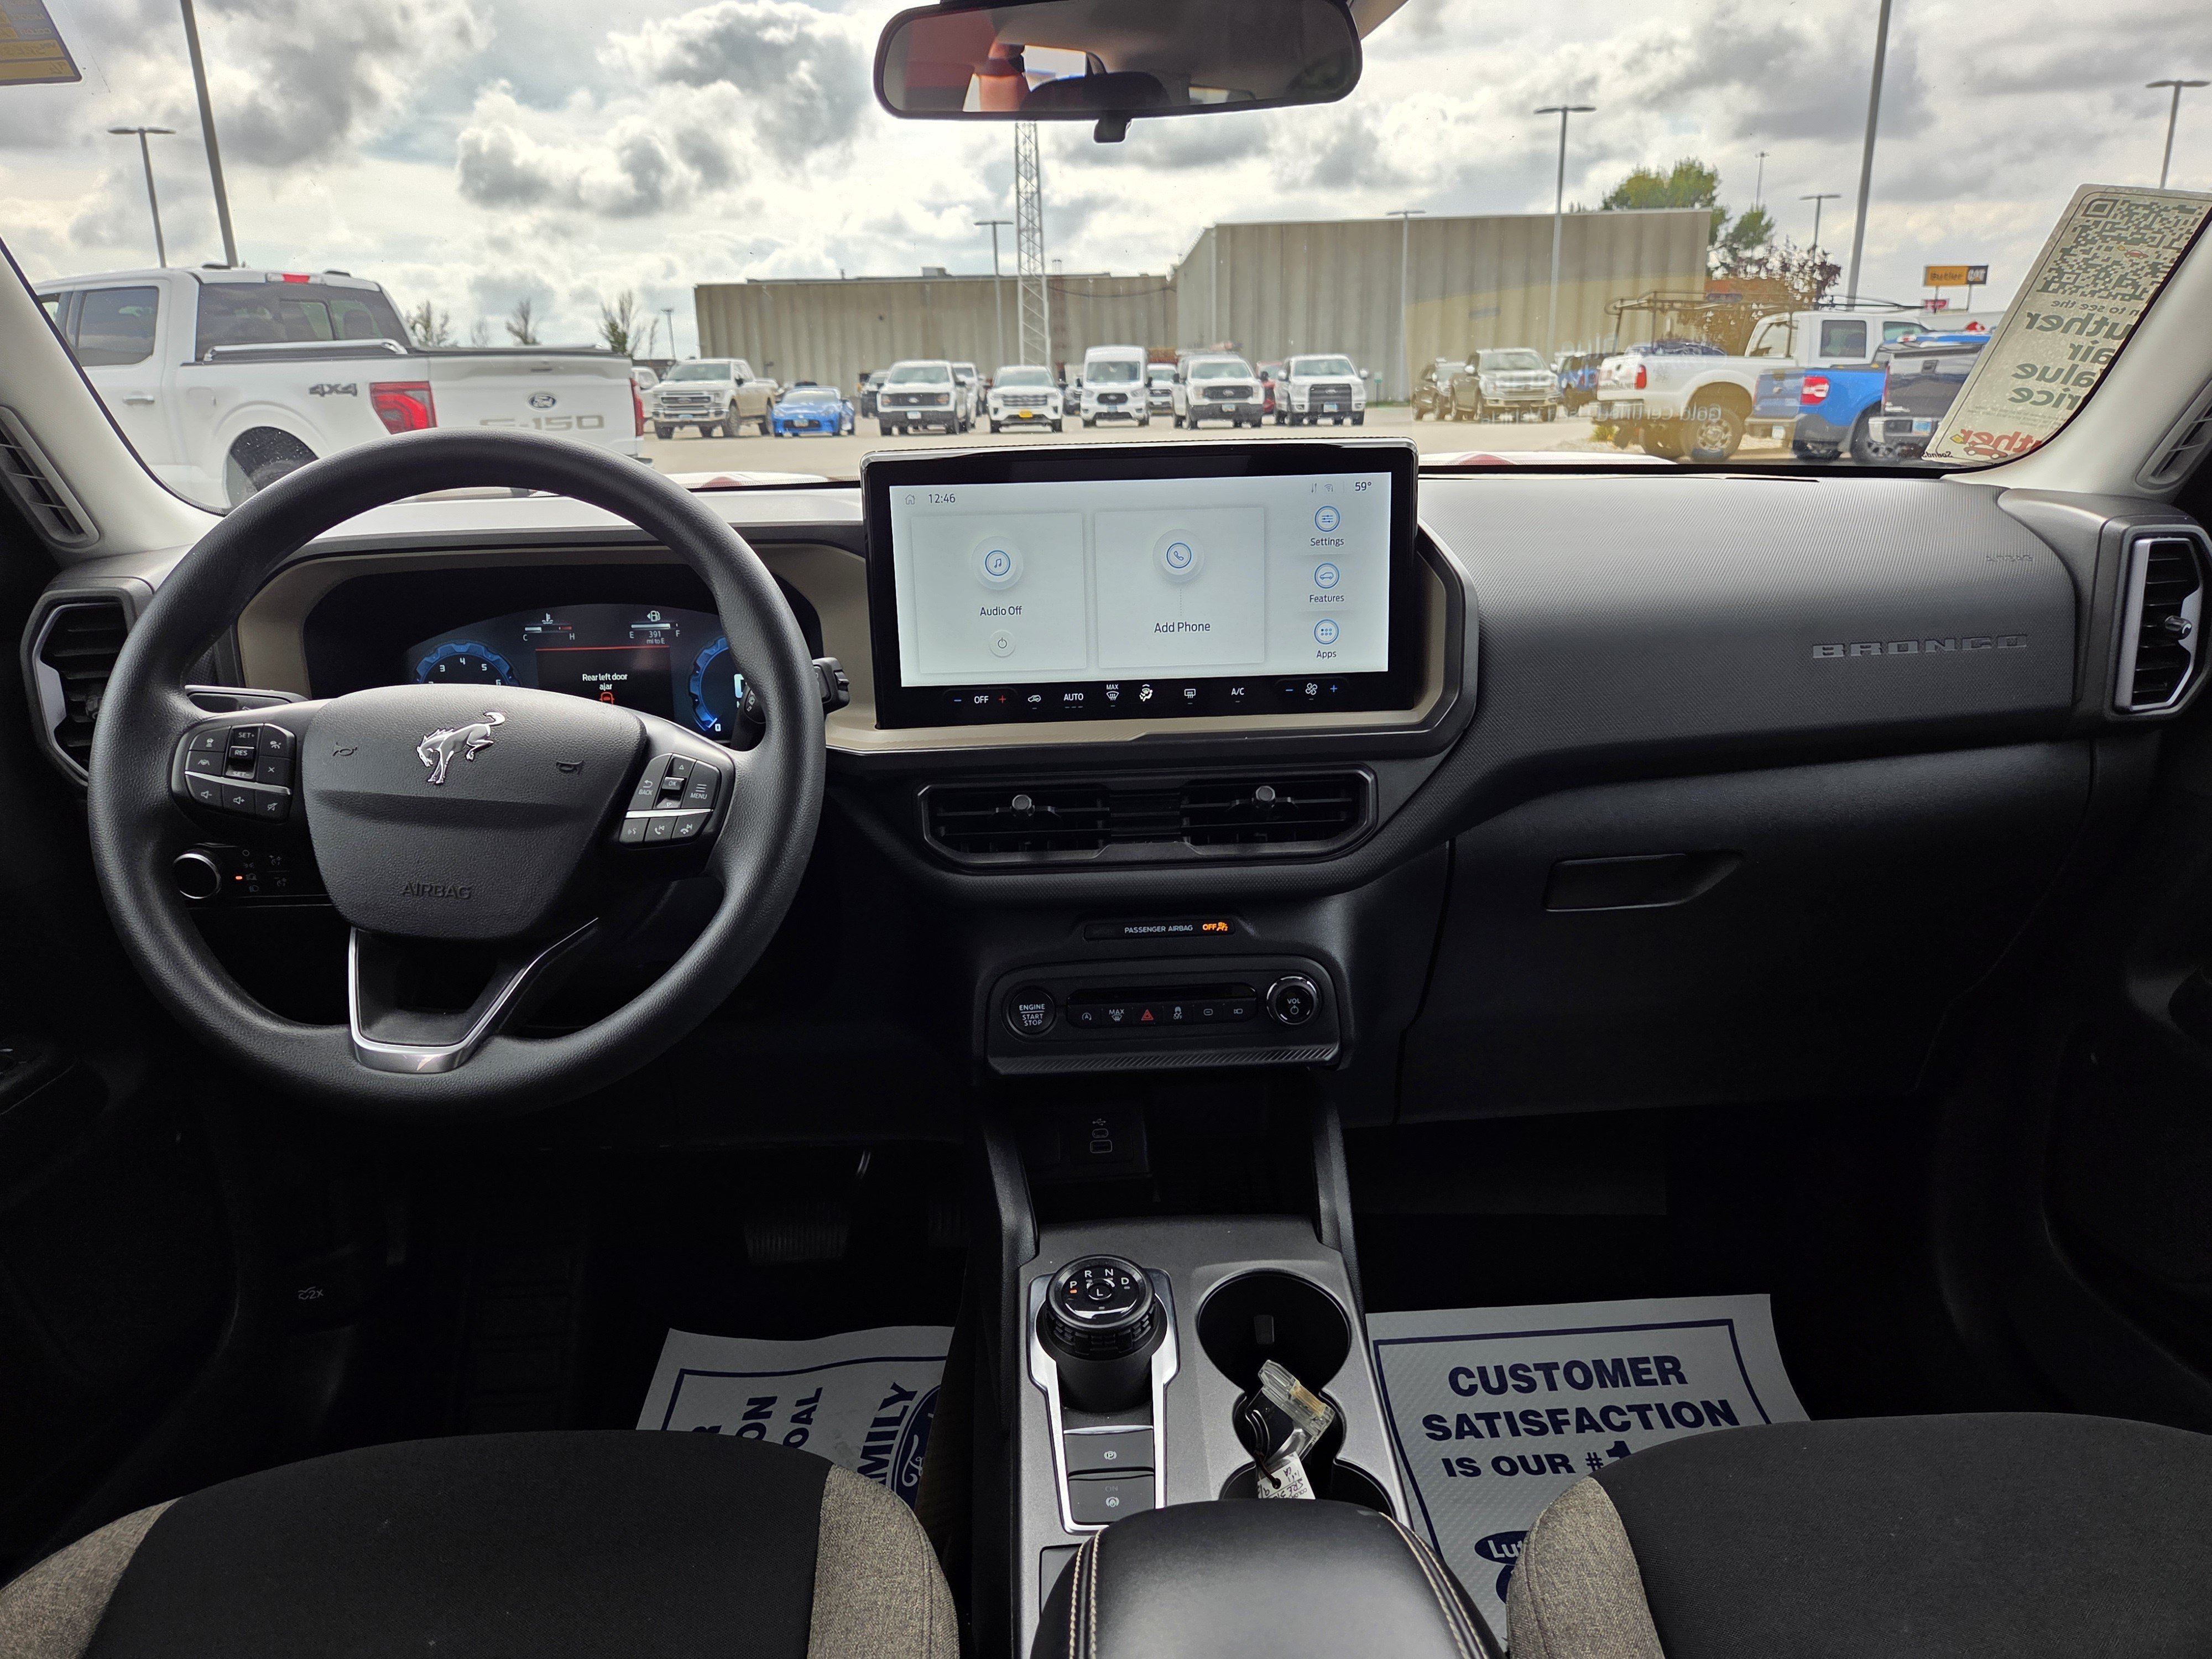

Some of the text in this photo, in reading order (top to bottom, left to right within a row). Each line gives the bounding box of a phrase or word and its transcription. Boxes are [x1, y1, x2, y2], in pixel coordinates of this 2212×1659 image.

[1354, 482, 1372, 491] 59°
[928, 494, 956, 504] 12:46
[1310, 537, 1344, 547] Settings
[1309, 594, 1344, 603] Features
[979, 606, 1022, 616] Audio Off
[1154, 622, 1211, 633] Add Phone
[1813, 634, 2028, 658] BRONCO
[1316, 650, 1337, 659] Apps
[599, 683, 612, 691] ajar
[1231, 687, 1244, 696] A/C
[974, 696, 989, 705] OFF
[1063, 693, 1084, 701] AUTO
[402, 883, 471, 900] AIRBAG
[1124, 925, 1166, 933] PASSENGER
[1019, 1003, 1045, 1011] ENGINE
[1024, 1019, 1042, 1027] STOP
[1121, 1277, 1129, 1285] D
[1447, 1355, 1688, 1397] CUSTOMER
[782, 1387, 823, 1449] OAL
[1422, 1399, 1740, 1441] SATISFACTION
[1441, 1457, 1482, 1478] IS
[1492, 1453, 1576, 1477] OUR
